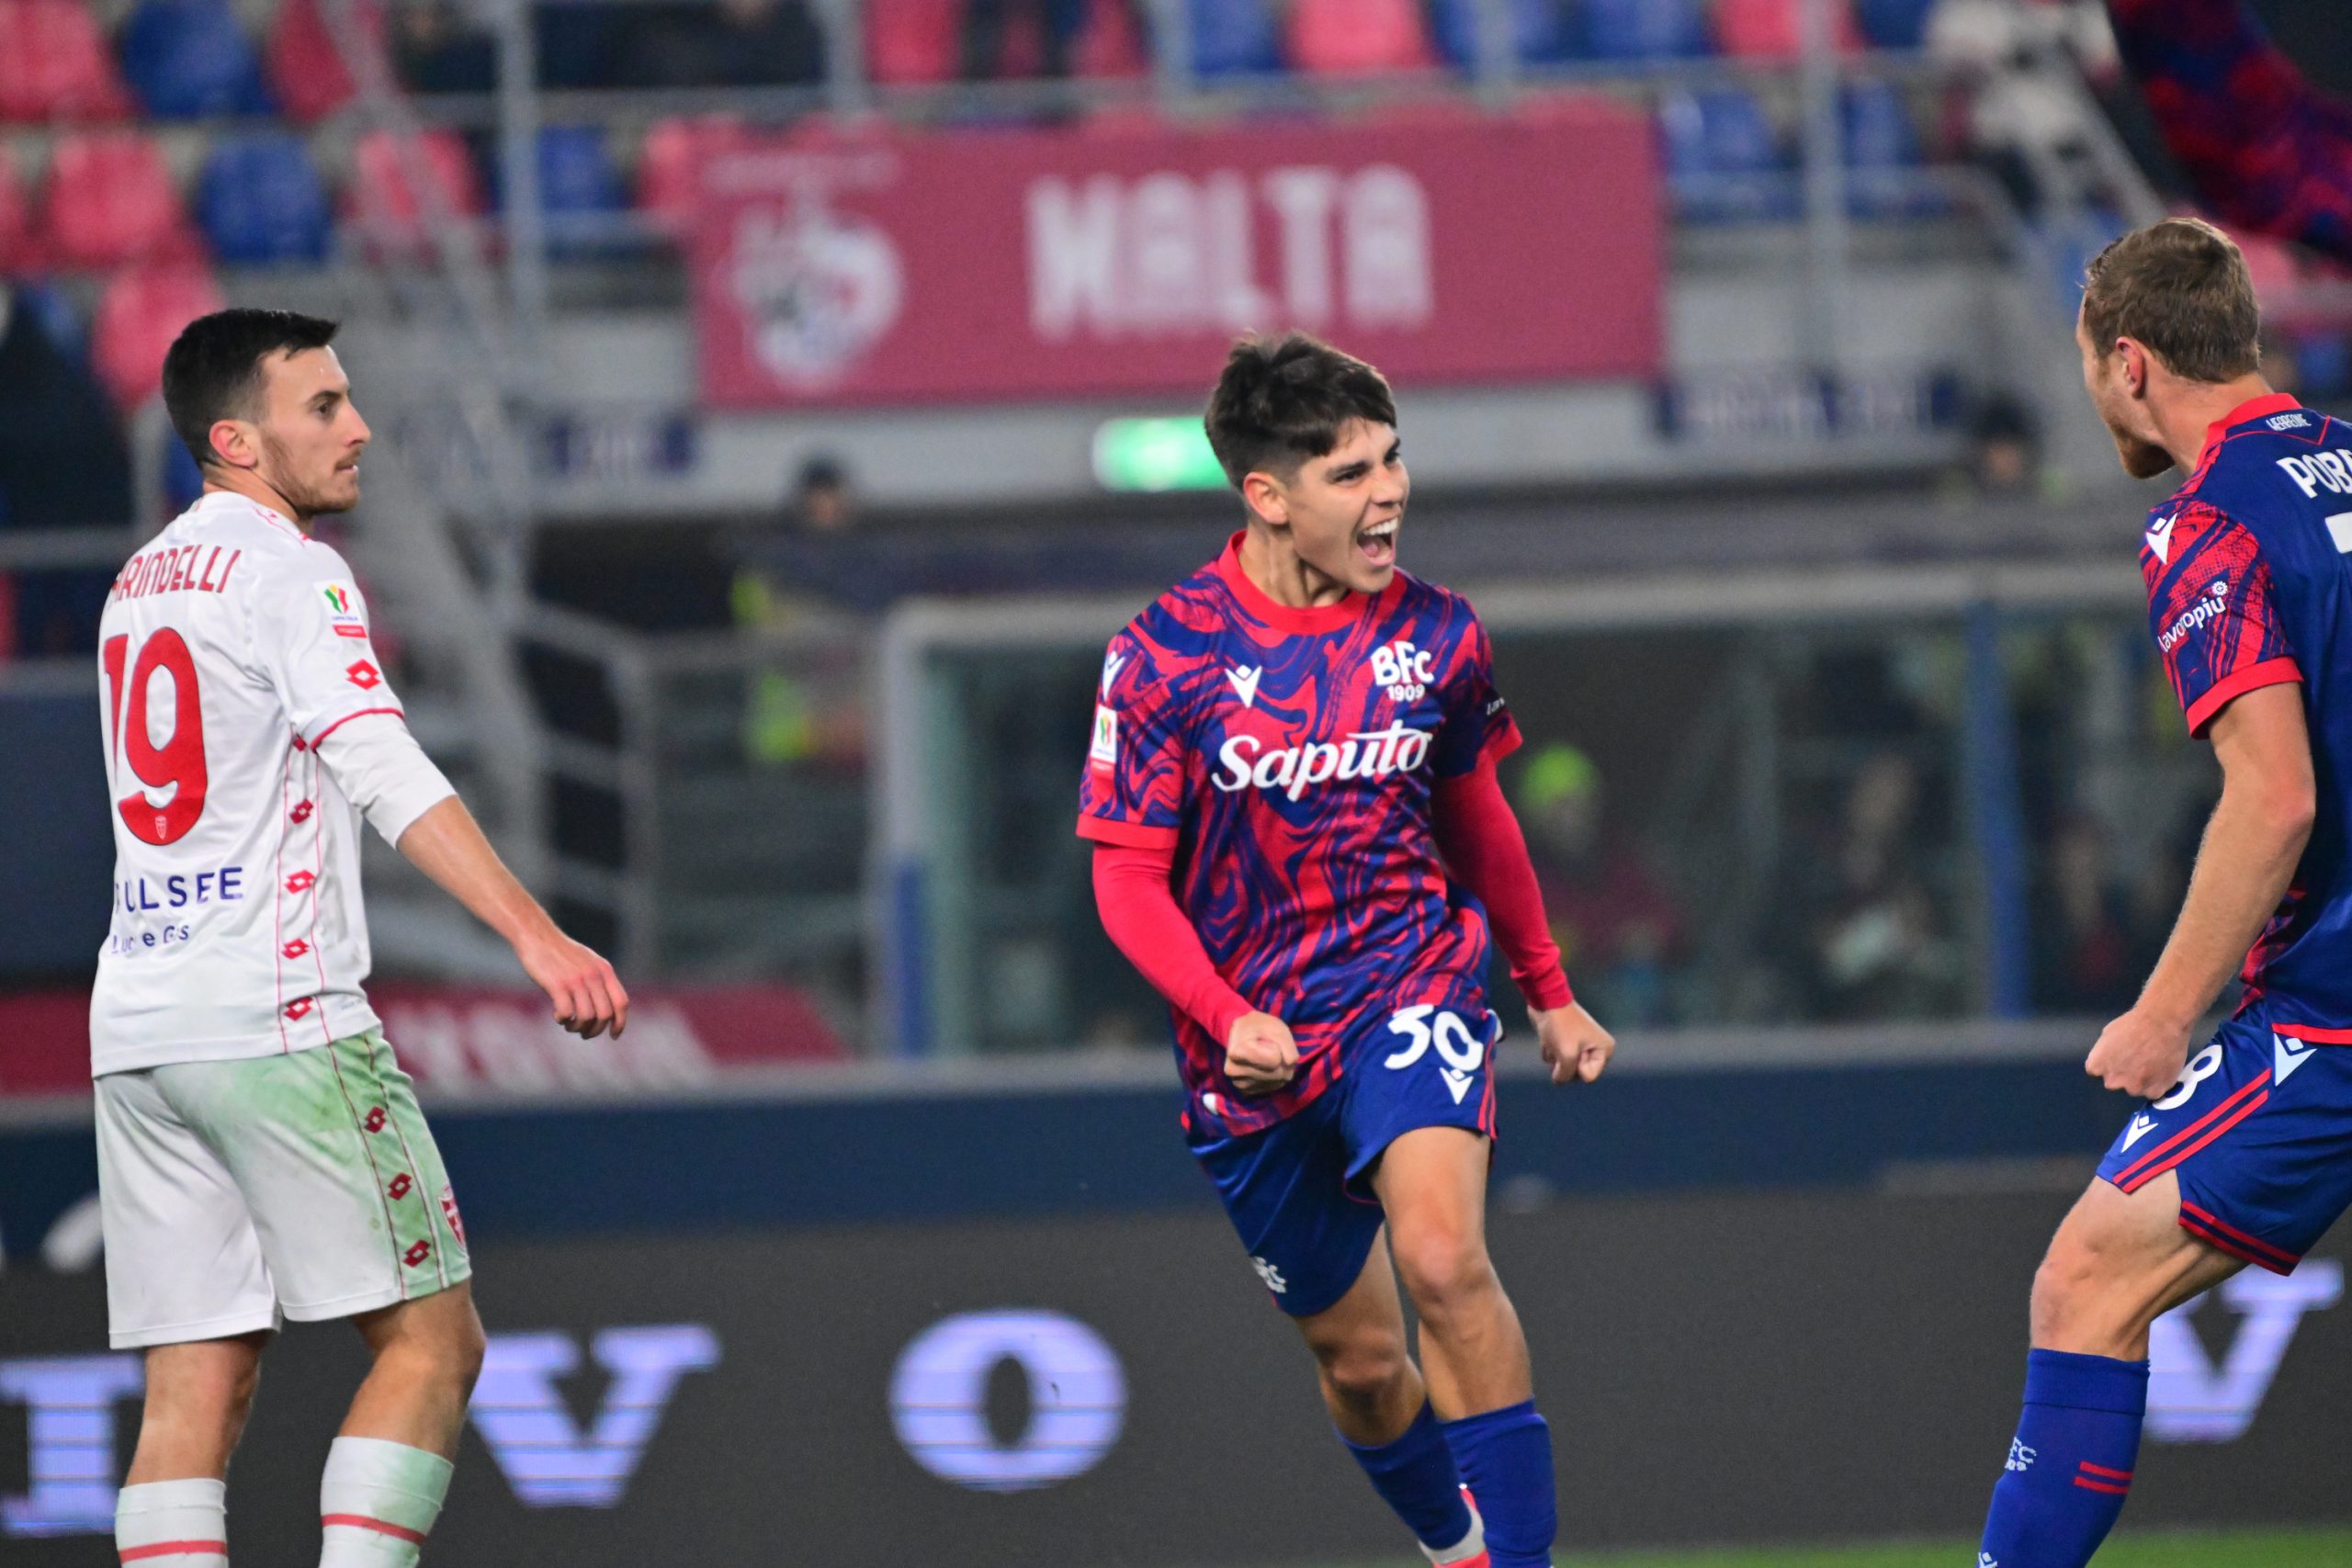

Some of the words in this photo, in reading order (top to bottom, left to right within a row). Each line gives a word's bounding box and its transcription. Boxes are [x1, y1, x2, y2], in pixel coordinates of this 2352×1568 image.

[1025, 165, 1434, 340] MALTA
[1371, 640, 1434, 685] BFC
[1387, 683, 1425, 702] 1909
[104, 626, 208, 846] 19
[1211, 719, 1433, 803] Saputo
